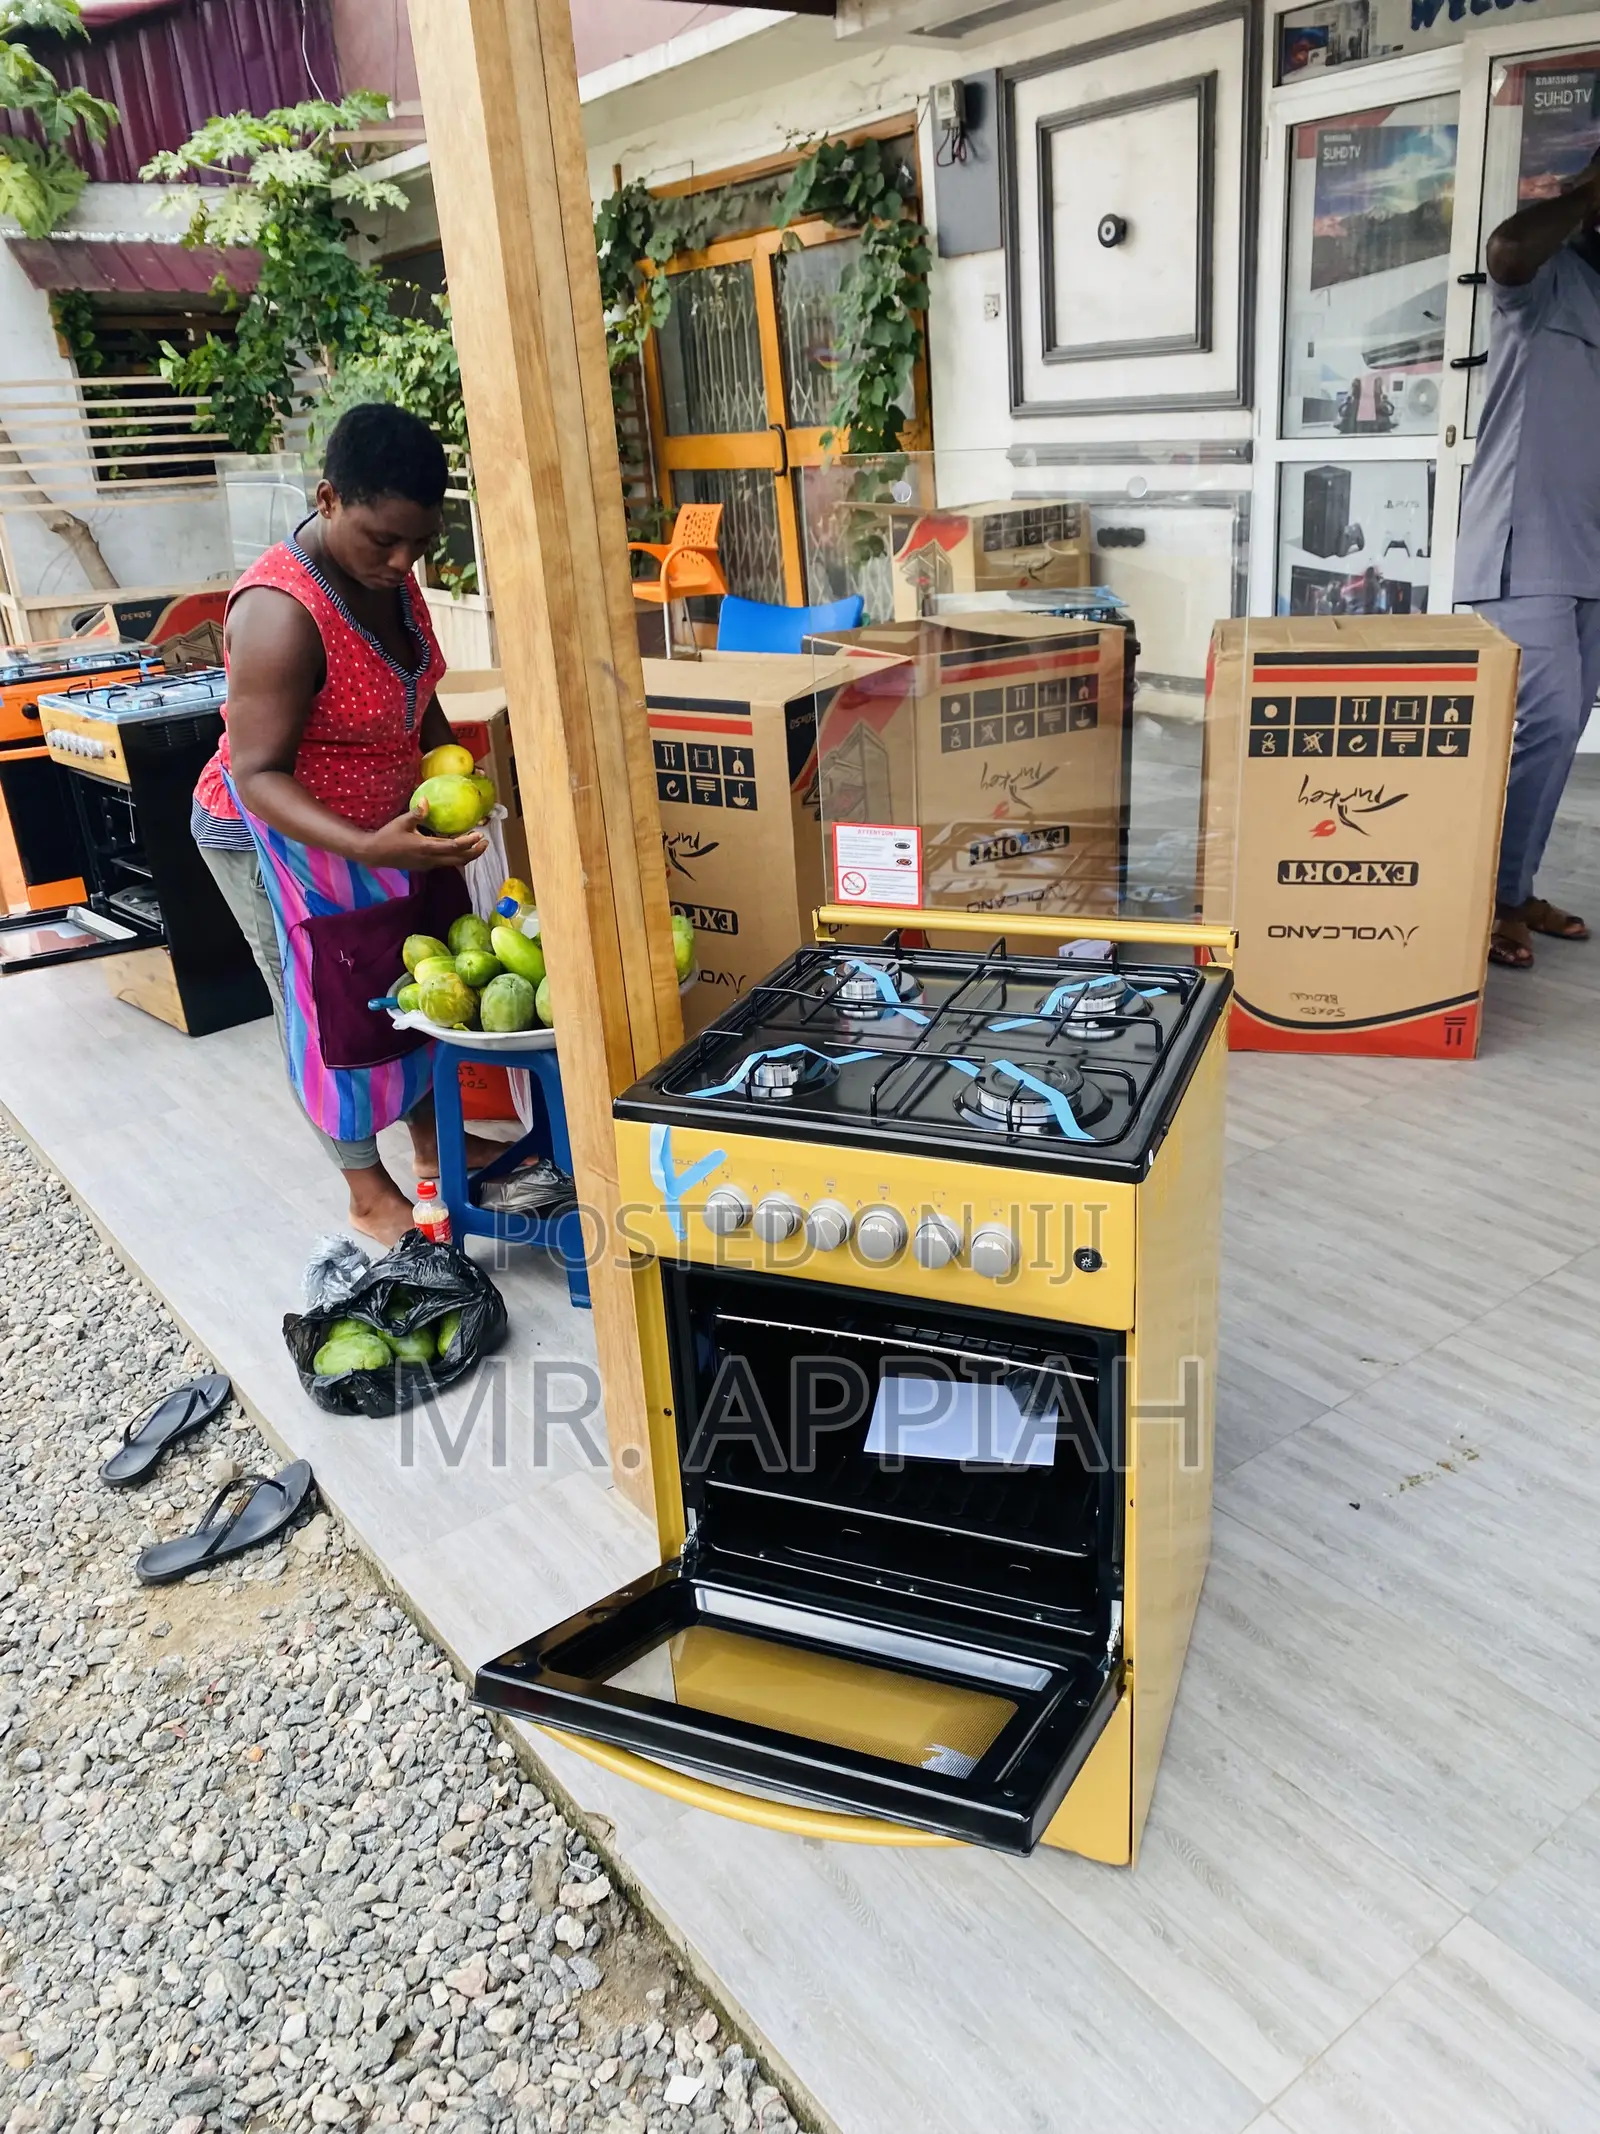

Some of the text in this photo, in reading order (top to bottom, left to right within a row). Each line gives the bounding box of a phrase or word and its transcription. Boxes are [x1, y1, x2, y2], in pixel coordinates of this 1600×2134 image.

[1534, 88, 1592, 107] SUHD TV
[1297, 774, 1410, 820] Turkey
[1281, 861, 1414, 885] EXPORT
[1267, 924, 1396, 941] VOLCANO
